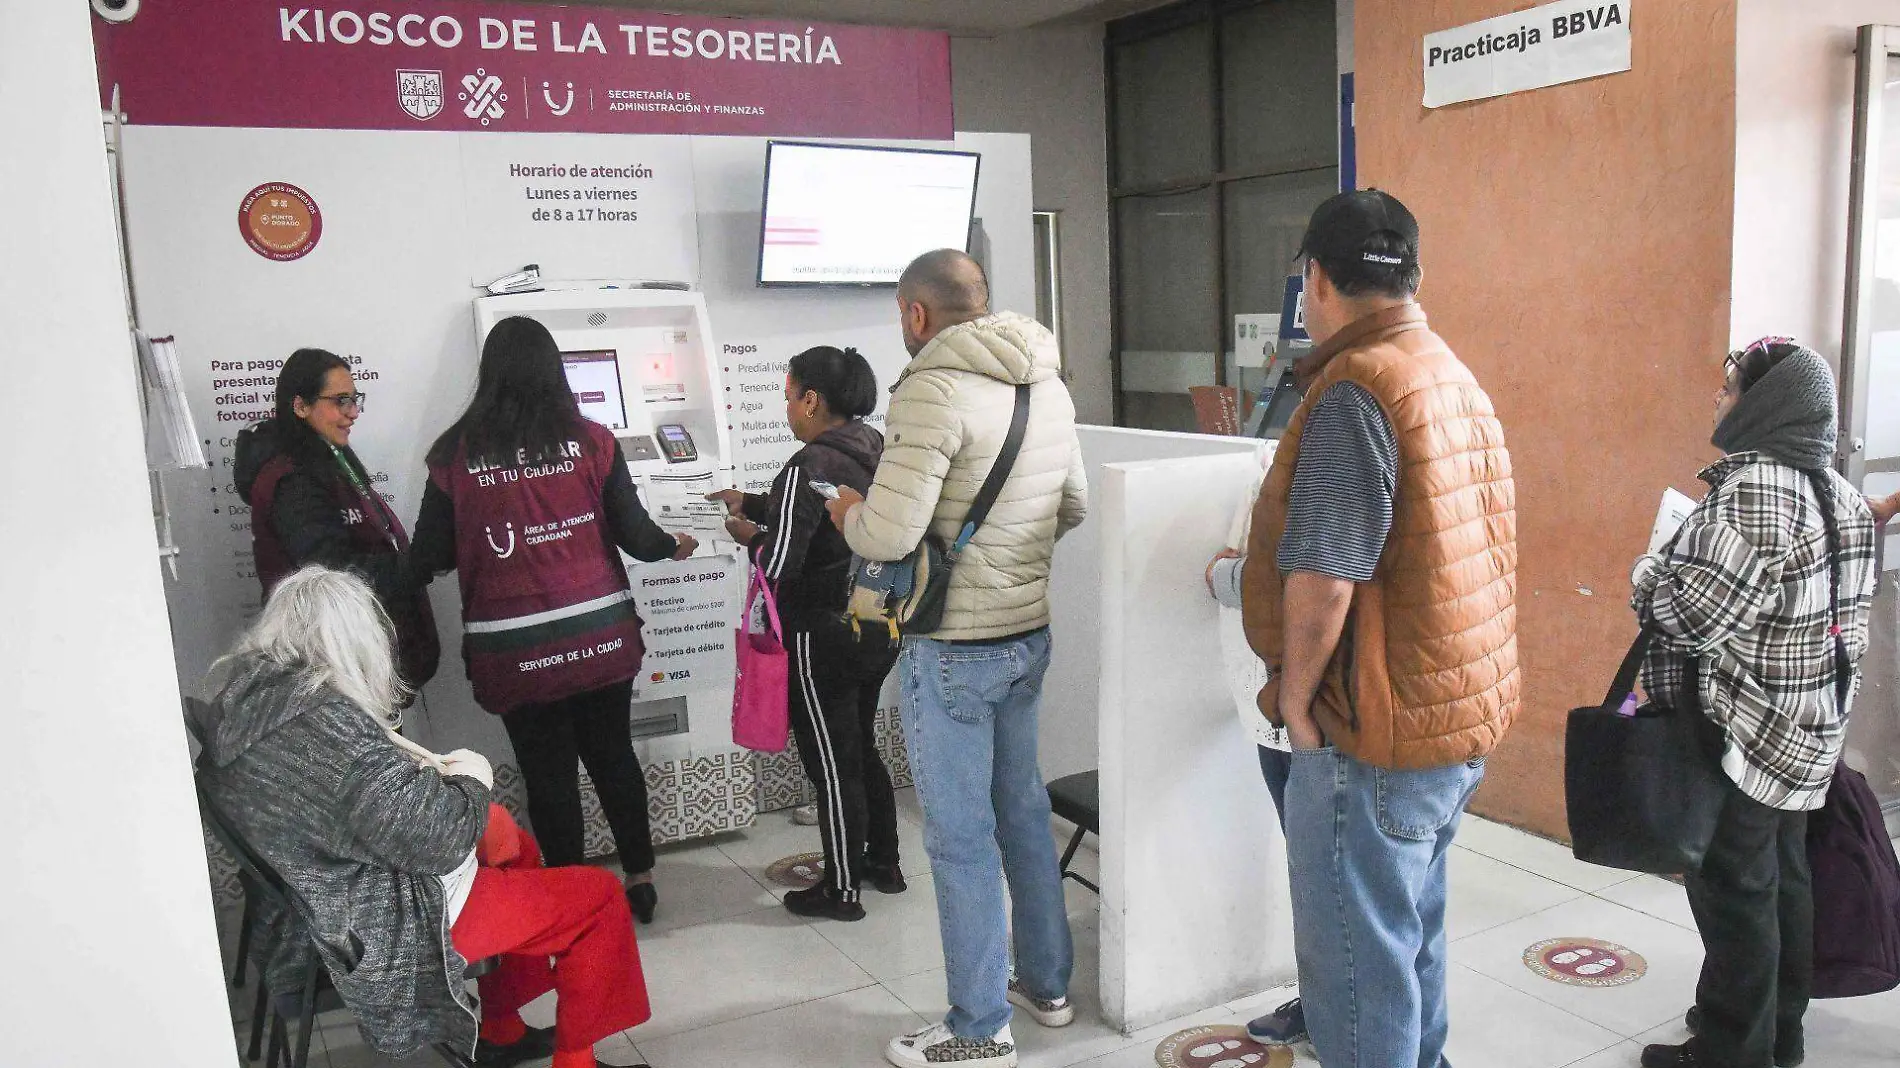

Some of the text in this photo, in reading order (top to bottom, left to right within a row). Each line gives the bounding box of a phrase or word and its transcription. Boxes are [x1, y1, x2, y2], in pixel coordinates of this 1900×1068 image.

[279, 8, 842, 65] KIOSCO DE LA TESORERÍA
[1428, 3, 1622, 67] Practicaja BBVA
[608, 89, 691, 101] SECRETARÍA DE
[609, 102, 765, 115] ADMINISTRACIÓN Y FINANZAS
[509, 163, 653, 178] Horario de atención
[526, 187, 638, 201] Lunes a viernes
[286, 187, 317, 215] IMPUESTOS
[532, 208, 637, 221] de 8 a 17 horas
[723, 344, 757, 355] Pagos
[211, 359, 284, 371] Para pago
[738, 362, 770, 373] Predial
[739, 382, 780, 393] Tenencia
[215, 392, 259, 405] oficial
[740, 402, 763, 413] Agua
[217, 408, 276, 422] fotograf
[741, 420, 767, 431] Multa
[769, 420, 780, 429] de
[742, 437, 748, 448] y
[744, 460, 780, 471] Licencia
[478, 460, 575, 487] EN TU CIUDAD
[745, 479, 773, 490] Infracc
[524, 512, 595, 536] ÁREA DE ATENCIÓN
[526, 529, 573, 546] CIUDADANA
[642, 571, 725, 587] Formas de pago
[650, 597, 685, 608] Efectivo
[653, 620, 726, 636] Tarjeta de crédito
[519, 638, 623, 672] SERVIDOR DE LA CIUDAD
[655, 642, 725, 659] Tarjeta de débito
[668, 670, 691, 680] VISA
